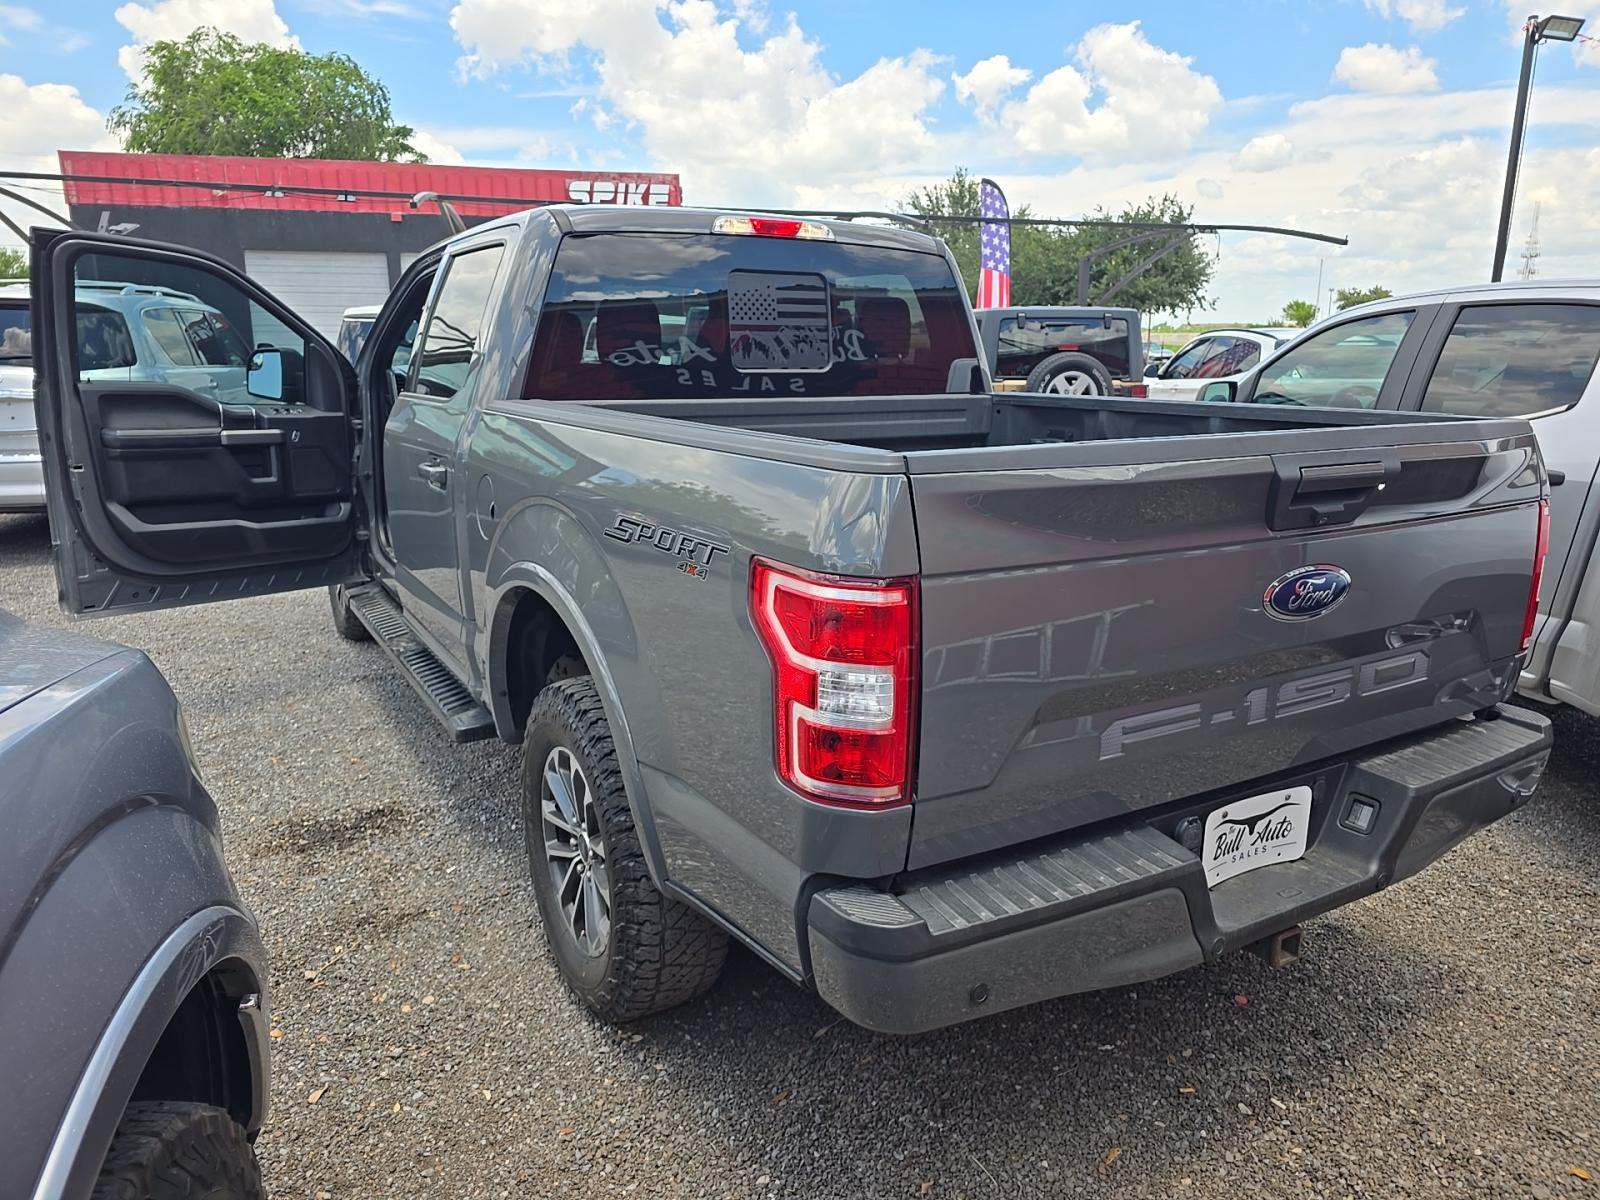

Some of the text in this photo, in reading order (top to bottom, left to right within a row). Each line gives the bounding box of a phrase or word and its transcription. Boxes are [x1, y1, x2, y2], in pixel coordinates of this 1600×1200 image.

[568, 181, 670, 206] SPIKE
[603, 513, 731, 566] SPORT
[1288, 577, 1337, 610] Ford
[1099, 650, 1430, 761] F-150
[1213, 815, 1293, 861] Bull Auto
[1231, 845, 1268, 863] SALES
